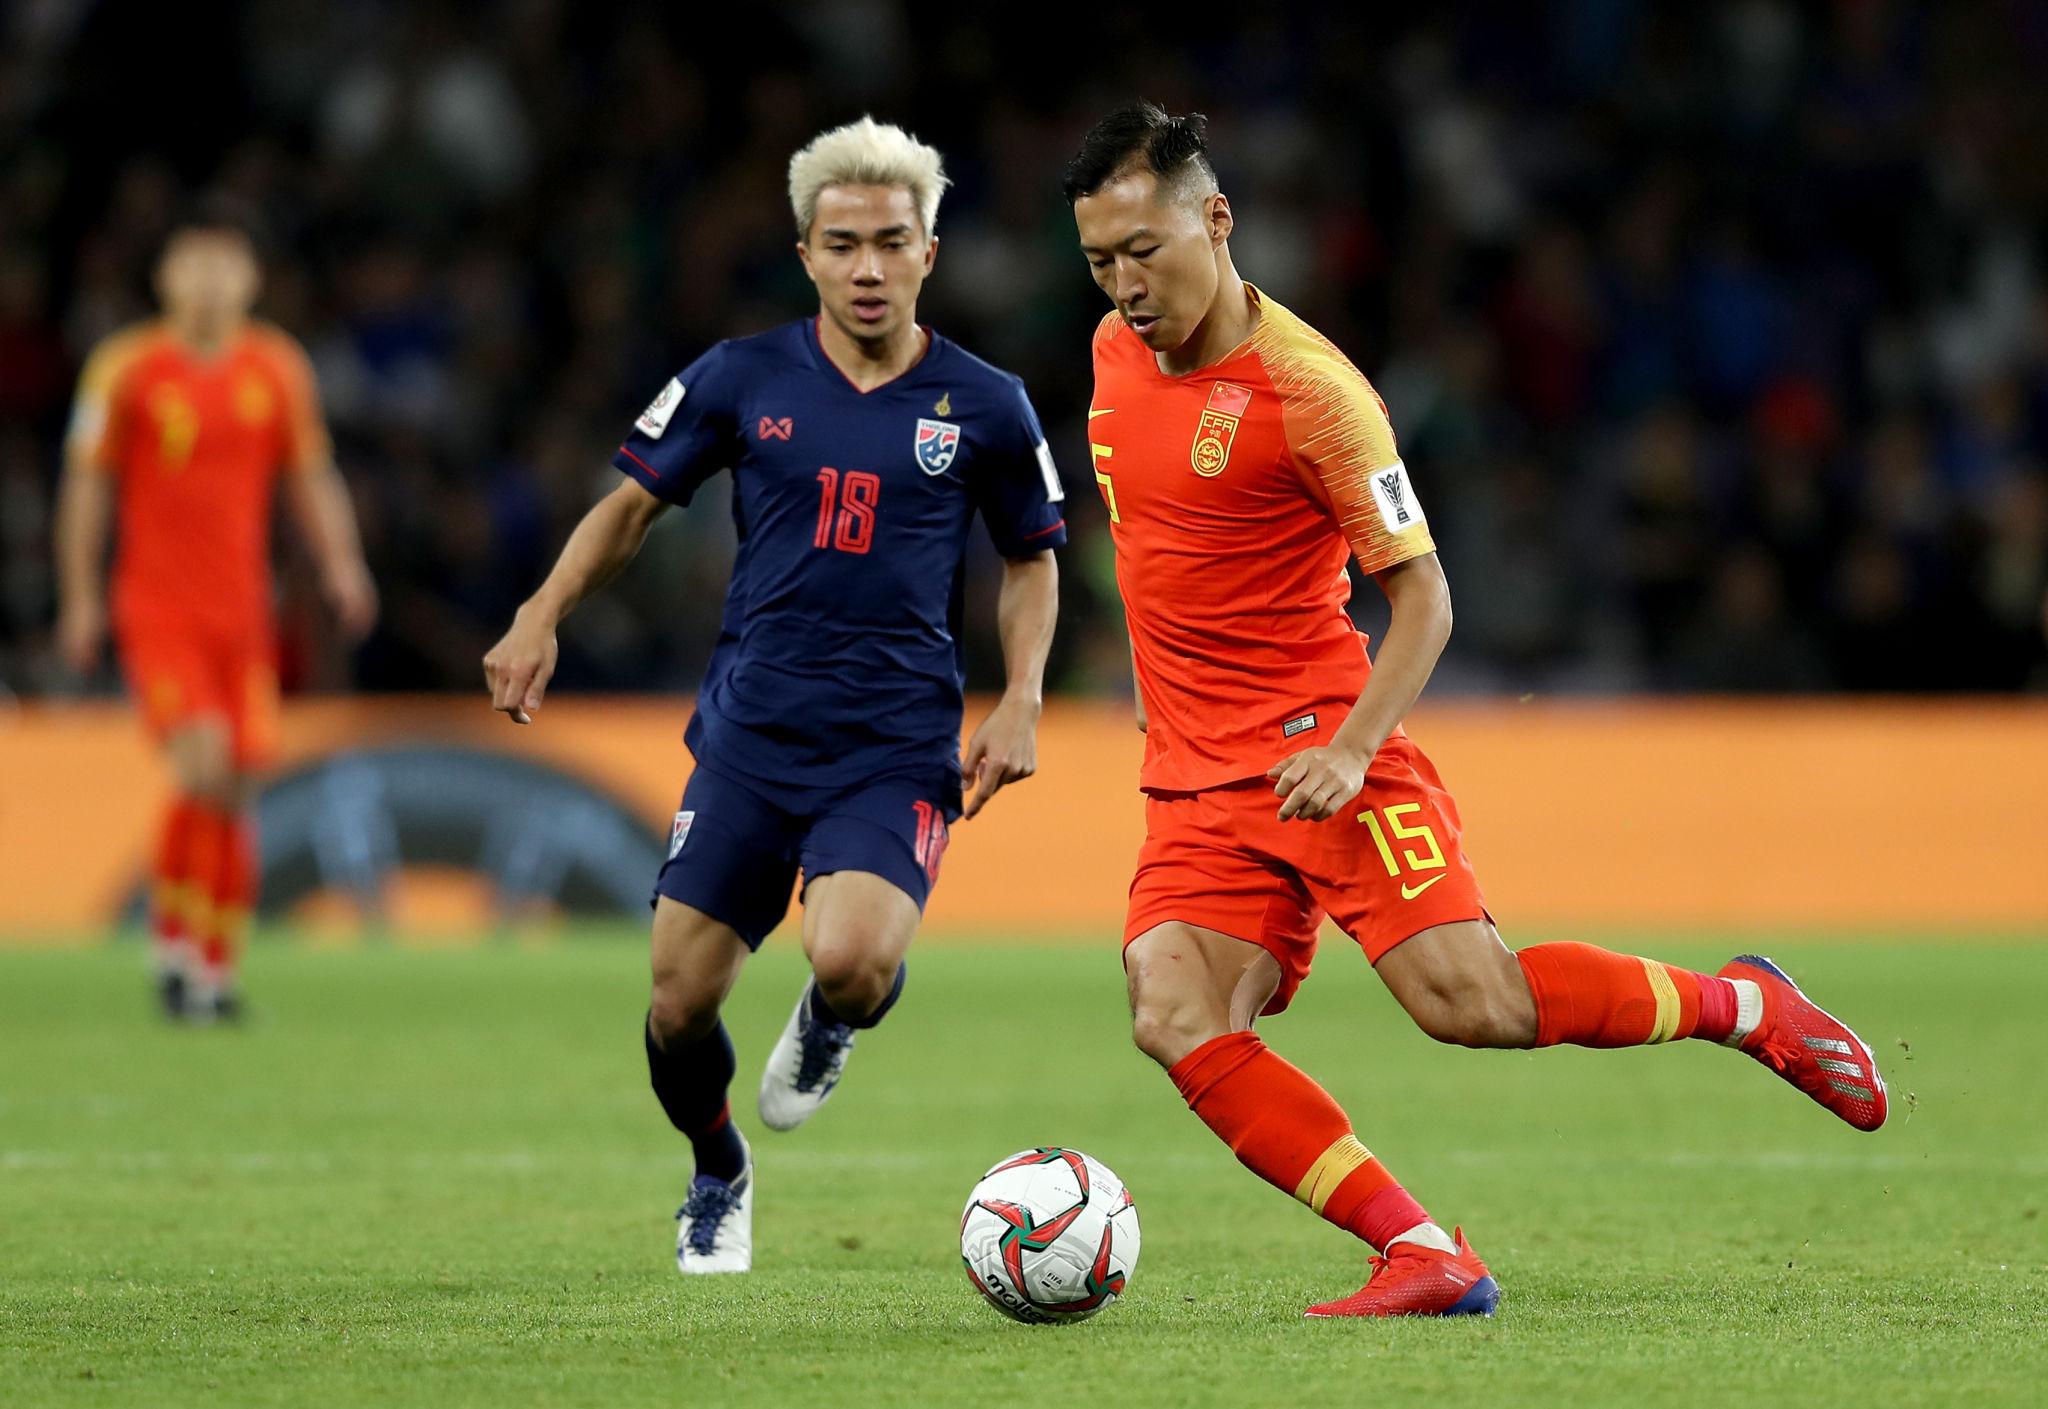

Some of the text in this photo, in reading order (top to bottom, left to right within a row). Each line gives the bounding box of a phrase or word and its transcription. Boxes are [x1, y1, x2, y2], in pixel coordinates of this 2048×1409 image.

[1203, 415, 1234, 432] CFA
[814, 466, 880, 555] 18
[1357, 802, 1447, 877] 15
[1046, 1272, 1062, 1285] FIFA
